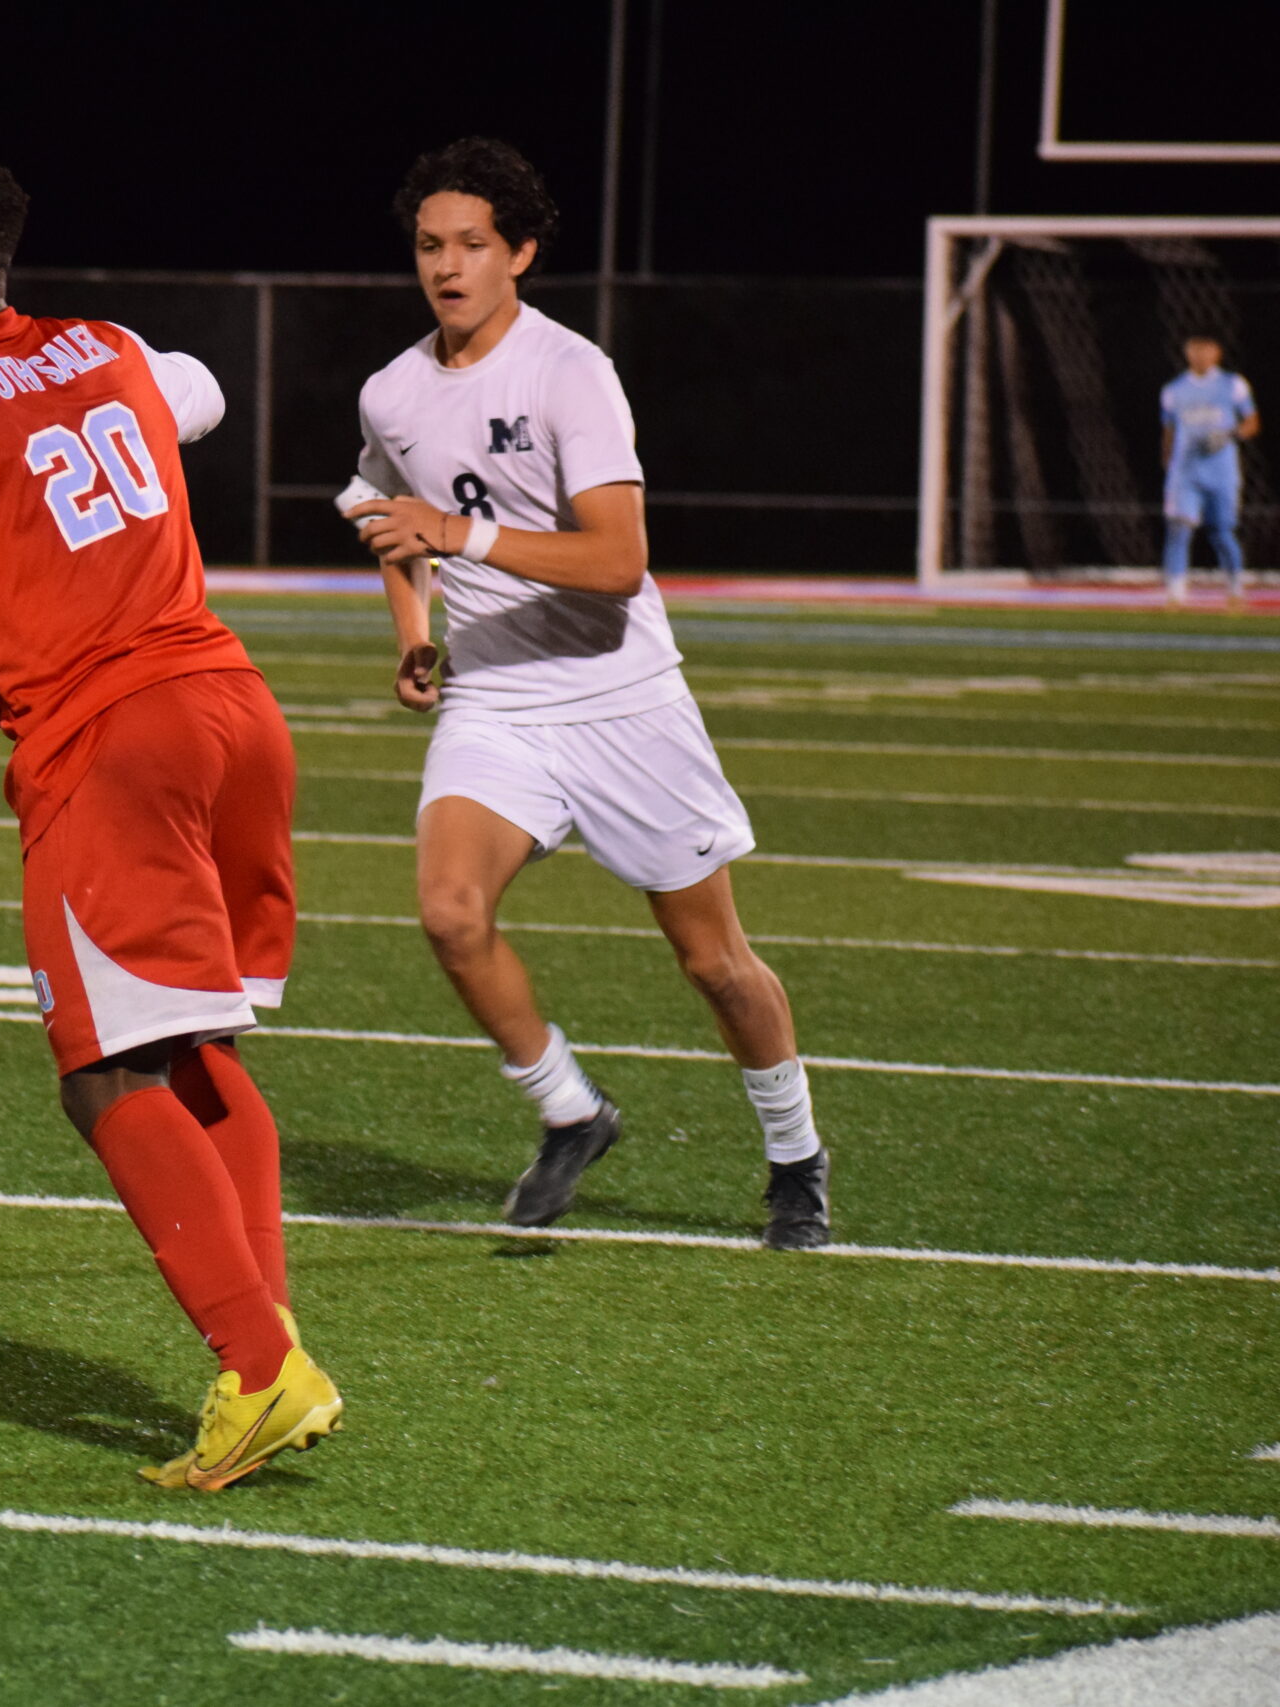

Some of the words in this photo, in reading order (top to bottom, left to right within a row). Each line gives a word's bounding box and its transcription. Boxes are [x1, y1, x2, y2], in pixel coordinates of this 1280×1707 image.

[488, 415, 534, 454] M
[24, 400, 169, 552] 20
[452, 472, 496, 523] 8
